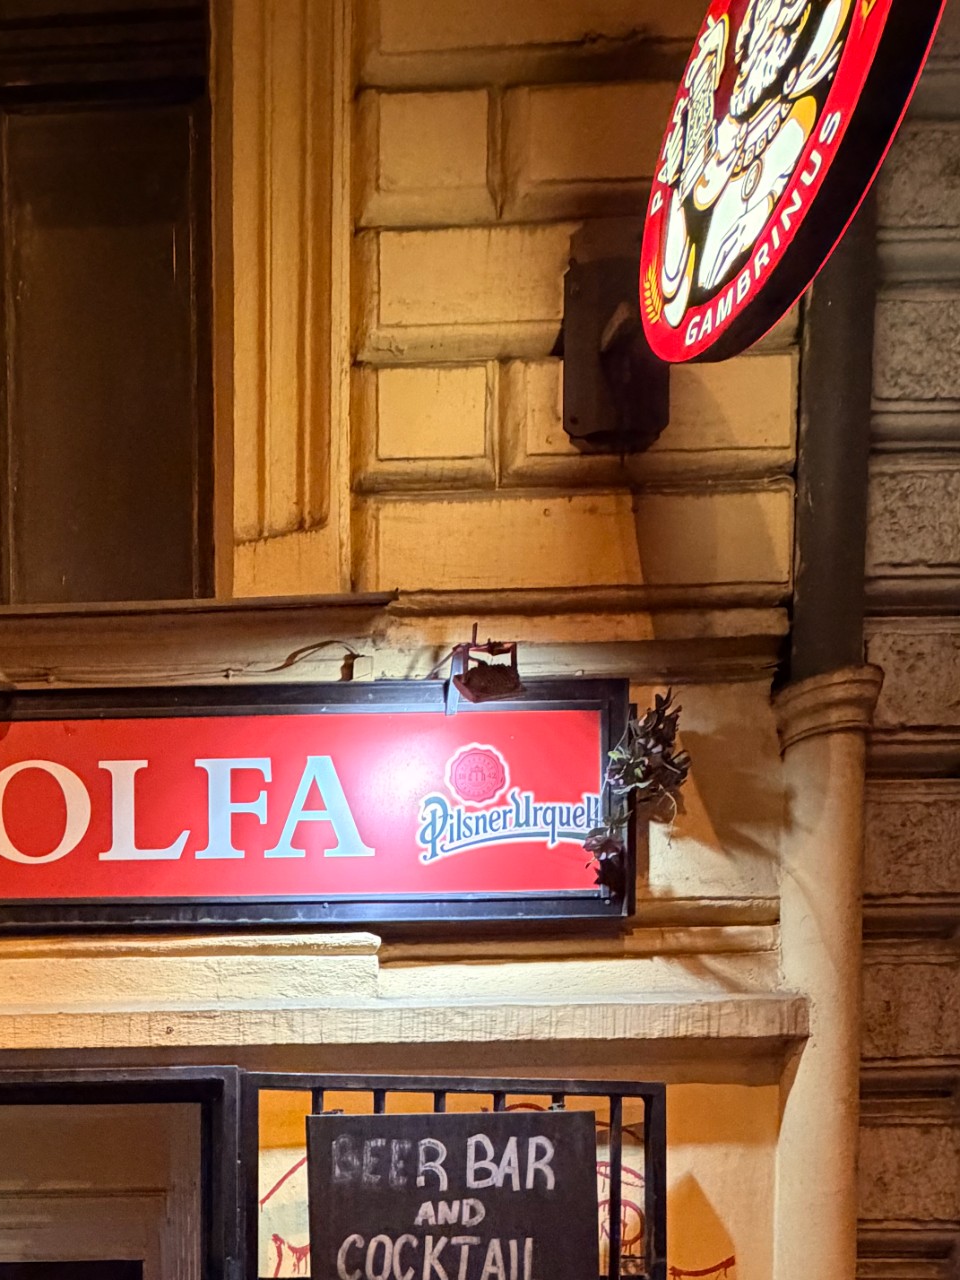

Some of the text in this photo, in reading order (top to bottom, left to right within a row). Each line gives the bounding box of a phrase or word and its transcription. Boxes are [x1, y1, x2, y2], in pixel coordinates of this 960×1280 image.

[685, 111, 841, 346] GAMBRINUS
[419, 790, 600, 861] Pilsner Urquell
[332, 1133, 556, 1191] BEER BAR
[414, 1198, 486, 1227] AND
